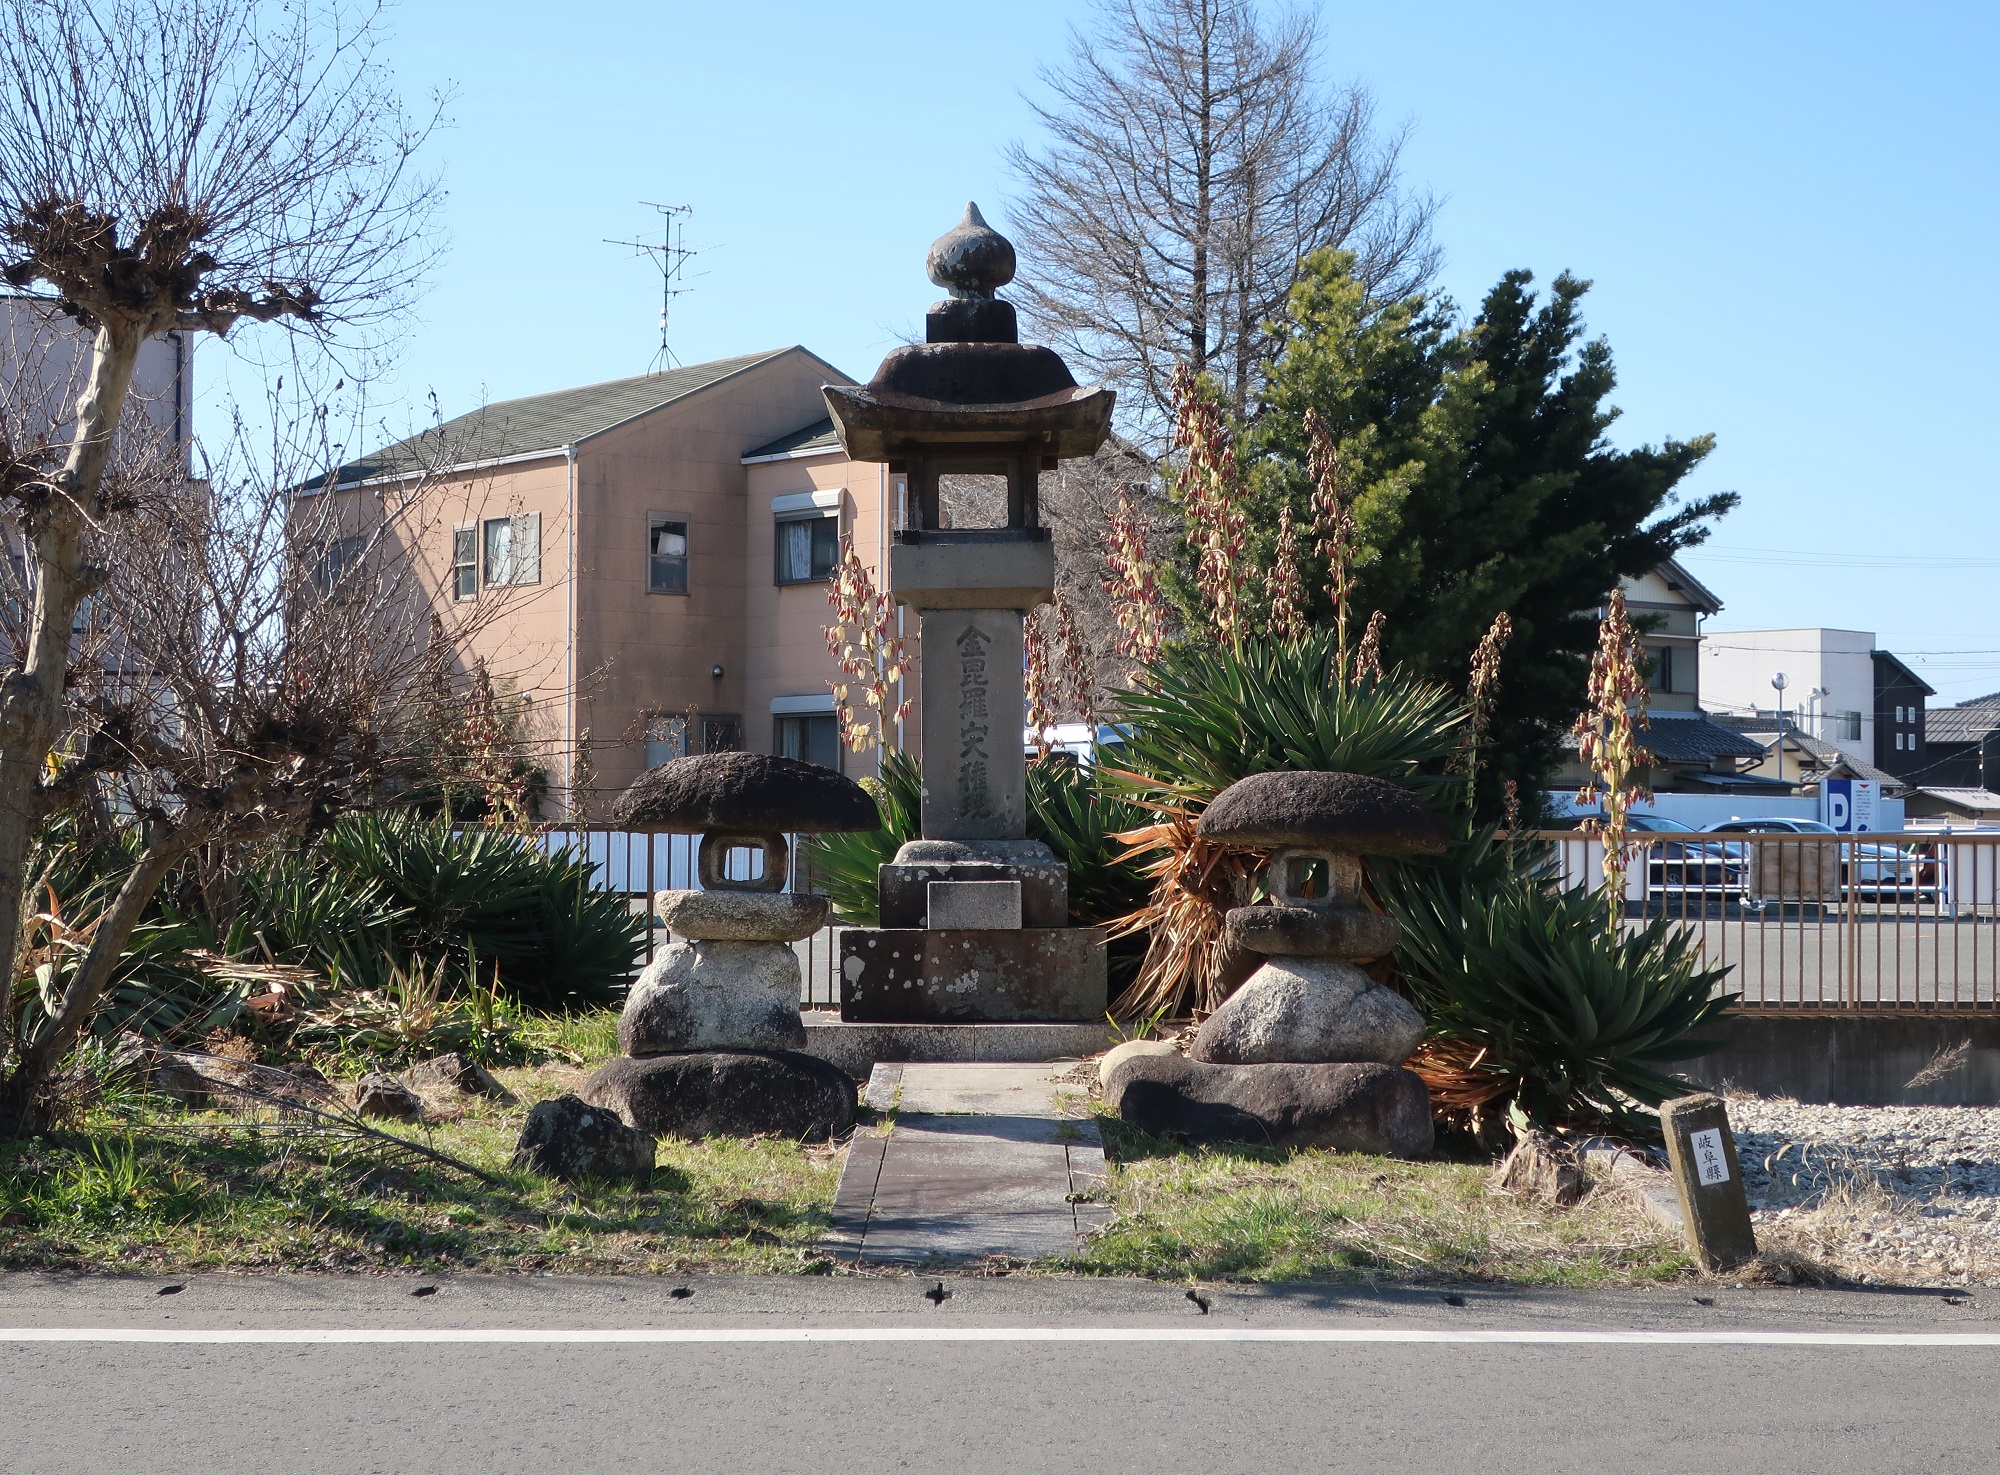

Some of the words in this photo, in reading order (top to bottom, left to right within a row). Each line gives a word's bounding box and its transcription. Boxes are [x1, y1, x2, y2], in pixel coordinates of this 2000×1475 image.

[1829, 793, 1849, 832] P
[1698, 1134, 1722, 1180] 岐阜縣
